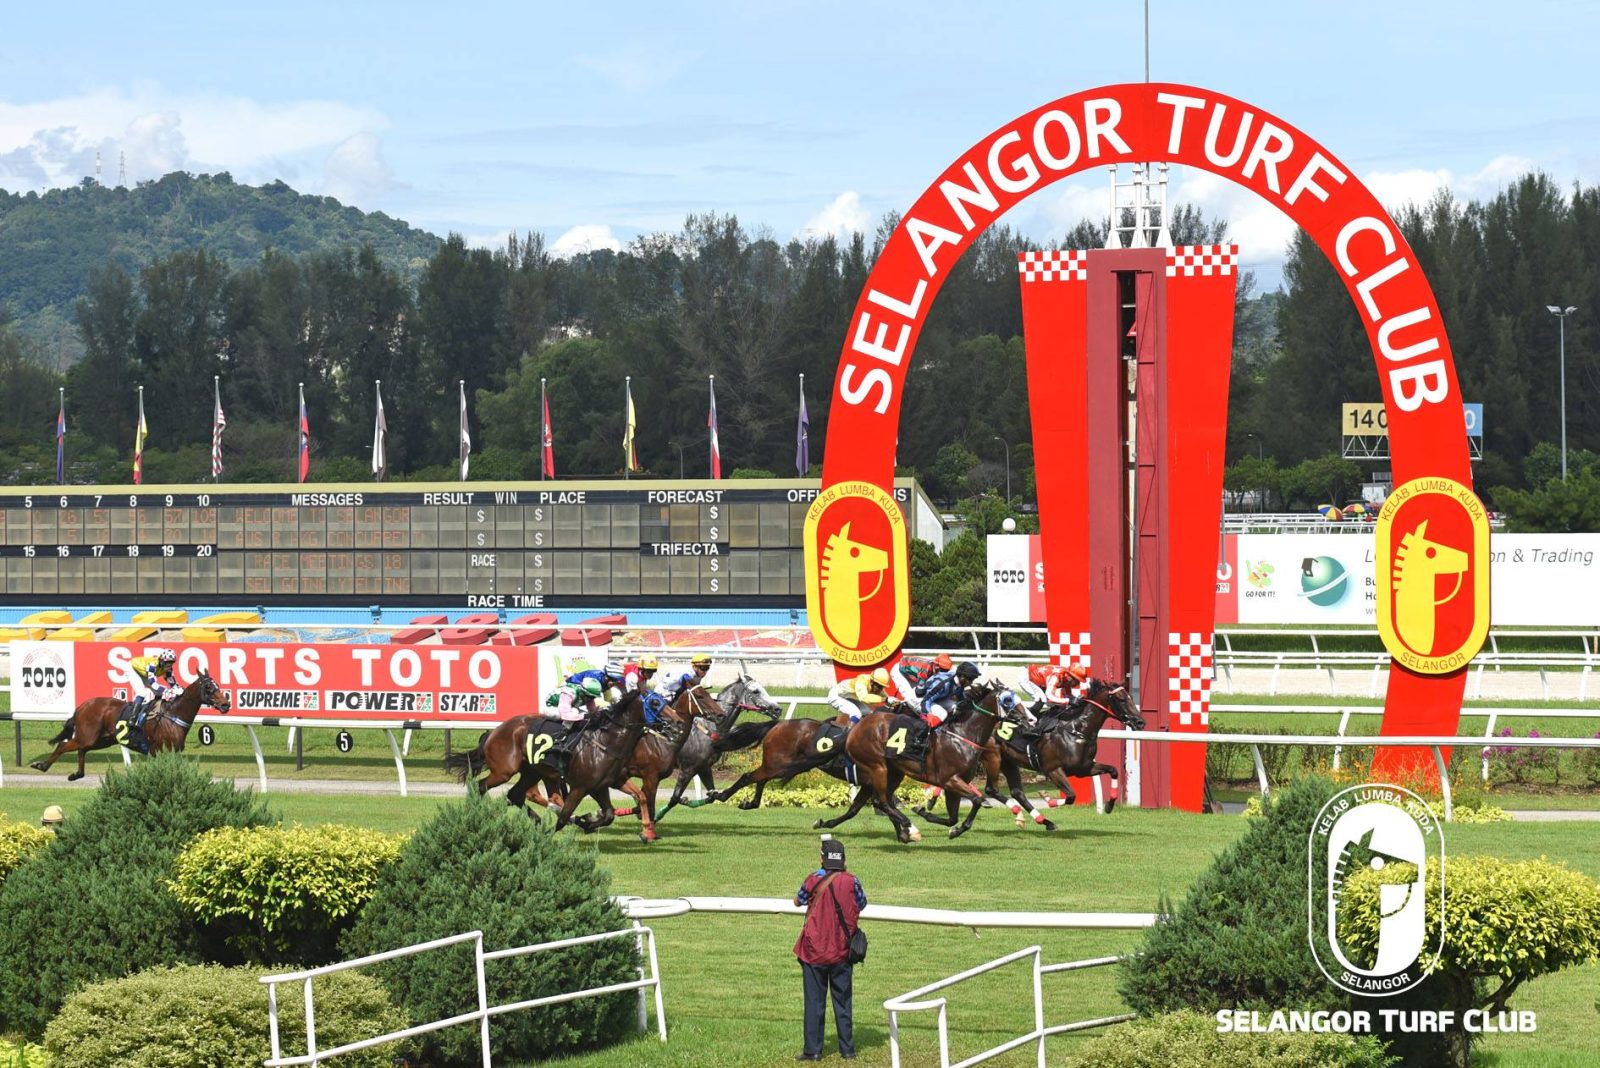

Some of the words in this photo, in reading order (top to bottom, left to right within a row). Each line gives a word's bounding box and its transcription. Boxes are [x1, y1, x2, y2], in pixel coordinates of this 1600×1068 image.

[839, 97, 1133, 415] SELANGOR
[1158, 92, 1348, 207] TURF
[1335, 216, 1449, 413] CLUB
[25, 496, 32, 508] 5
[60, 496, 68, 508] 6
[94, 495, 102, 507] 7
[129, 495, 137, 507] 8
[165, 495, 173, 507] 9
[197, 495, 210, 507] 10
[291, 494, 363, 506] MESSAGES
[423, 492, 474, 505] RESULT
[495, 492, 518, 504] WIN
[540, 491, 586, 504] PLACE
[648, 490, 723, 503] FORECAST
[1382, 488, 1411, 522] KELAB
[1414, 480, 1453, 494] LUMBA
[1458, 490, 1483, 522] KUDA
[809, 490, 836, 521] KELAB
[839, 484, 875, 499] LUMBA
[879, 495, 901, 526] KUDA
[477, 509, 485, 523] $
[534, 508, 543, 521] $
[710, 505, 719, 520] $
[477, 533, 485, 546] $
[534, 532, 543, 546] $
[710, 527, 719, 541] $
[23, 546, 36, 557] 15
[57, 546, 69, 557] 16
[91, 546, 104, 557] 17
[126, 546, 139, 557] 18
[161, 545, 175, 557] 19
[197, 545, 212, 557] 20
[652, 543, 719, 555] TRIFECTA
[471, 554, 496, 567] RACE
[534, 553, 543, 567] $
[1512, 548, 1524, 563] &
[1531, 548, 1594, 566] Trading
[710, 558, 719, 572] $
[993, 570, 1025, 583] TOTO
[534, 578, 543, 592] $
[710, 578, 719, 592] $
[467, 595, 505, 607] RACE
[512, 595, 544, 607] TIME
[831, 644, 890, 664] SELANGOR
[352, 648, 501, 689] TOTO
[1400, 652, 1465, 671] SELANGOR
[22, 667, 66, 688] TOTO
[239, 691, 301, 708] SUPREME
[331, 691, 415, 711] POWER
[440, 694, 479, 712] STAR
[115, 720, 130, 745] 2
[203, 726, 210, 744] 6
[341, 732, 348, 750] 5
[886, 728, 907, 755] 4
[526, 733, 553, 765] 12
